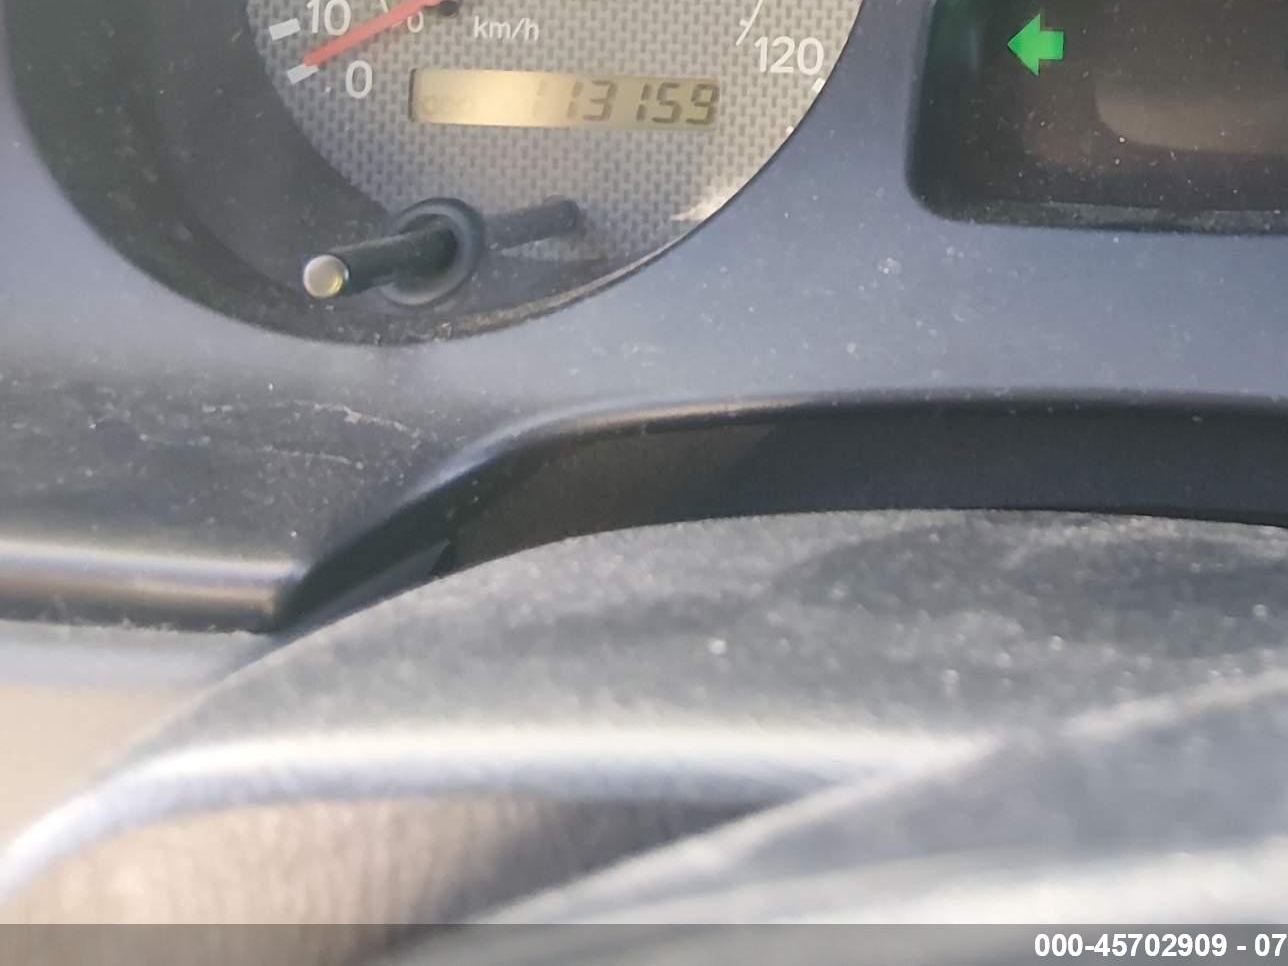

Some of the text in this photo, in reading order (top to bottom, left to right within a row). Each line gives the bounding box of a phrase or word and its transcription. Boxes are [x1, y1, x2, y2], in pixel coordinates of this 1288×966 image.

[472, 15, 540, 41] km/h
[753, 37, 826, 75] 120
[345, 60, 374, 99] 0
